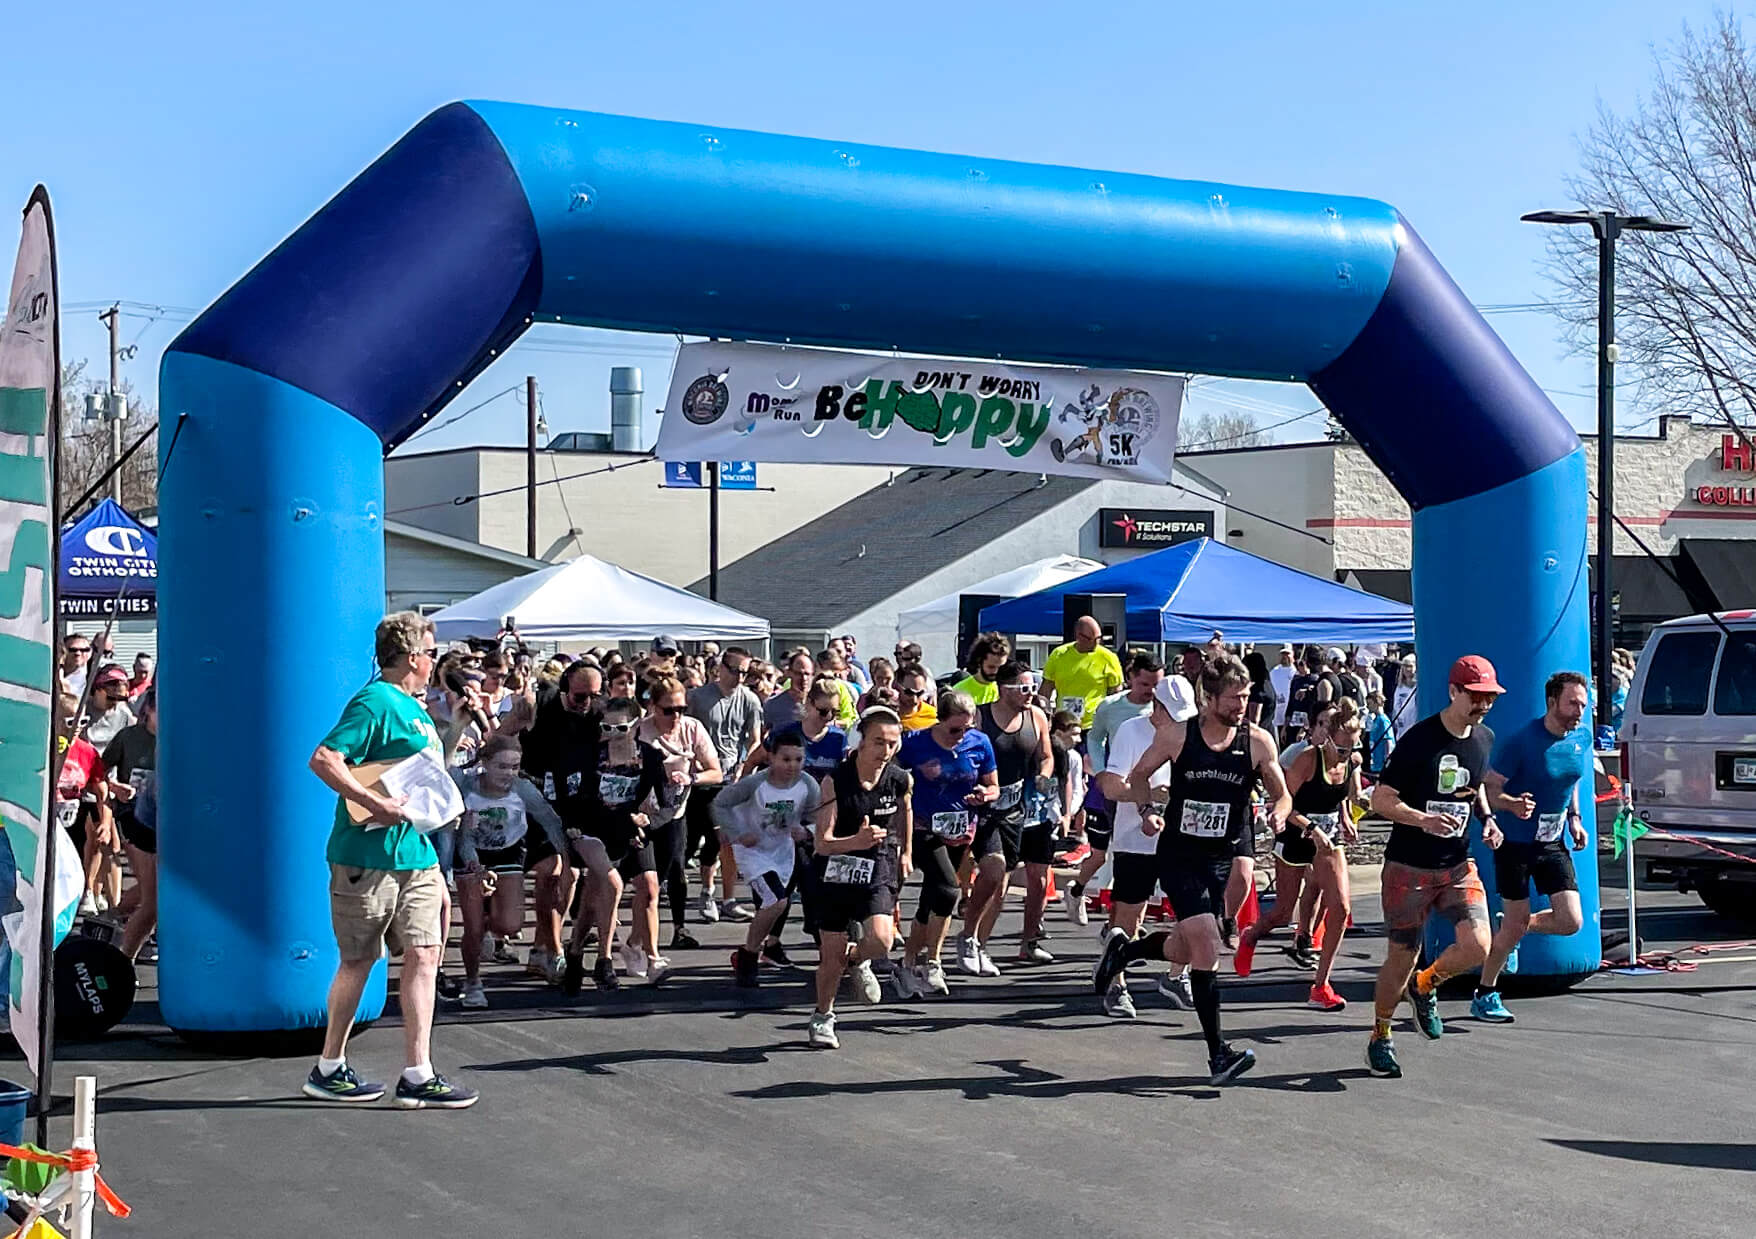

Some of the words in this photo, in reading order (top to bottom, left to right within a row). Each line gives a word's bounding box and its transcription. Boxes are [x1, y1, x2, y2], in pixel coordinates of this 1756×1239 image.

[915, 371, 971, 390] DON'T
[979, 375, 1041, 400] WORRY
[814, 385, 868, 421] Be
[774, 409, 801, 421] Run
[858, 379, 1051, 458] Hppy
[1109, 433, 1134, 457] 5K
[1721, 434, 1756, 472] H
[1136, 521, 1205, 533] TECHSTAR
[1142, 533, 1172, 541] Solutions
[72, 557, 118, 567] TWIN
[60, 600, 98, 613] TWIN
[1203, 815, 1226, 831] 281
[848, 868, 869, 885] 195
[74, 962, 105, 1015] MYLAPS
